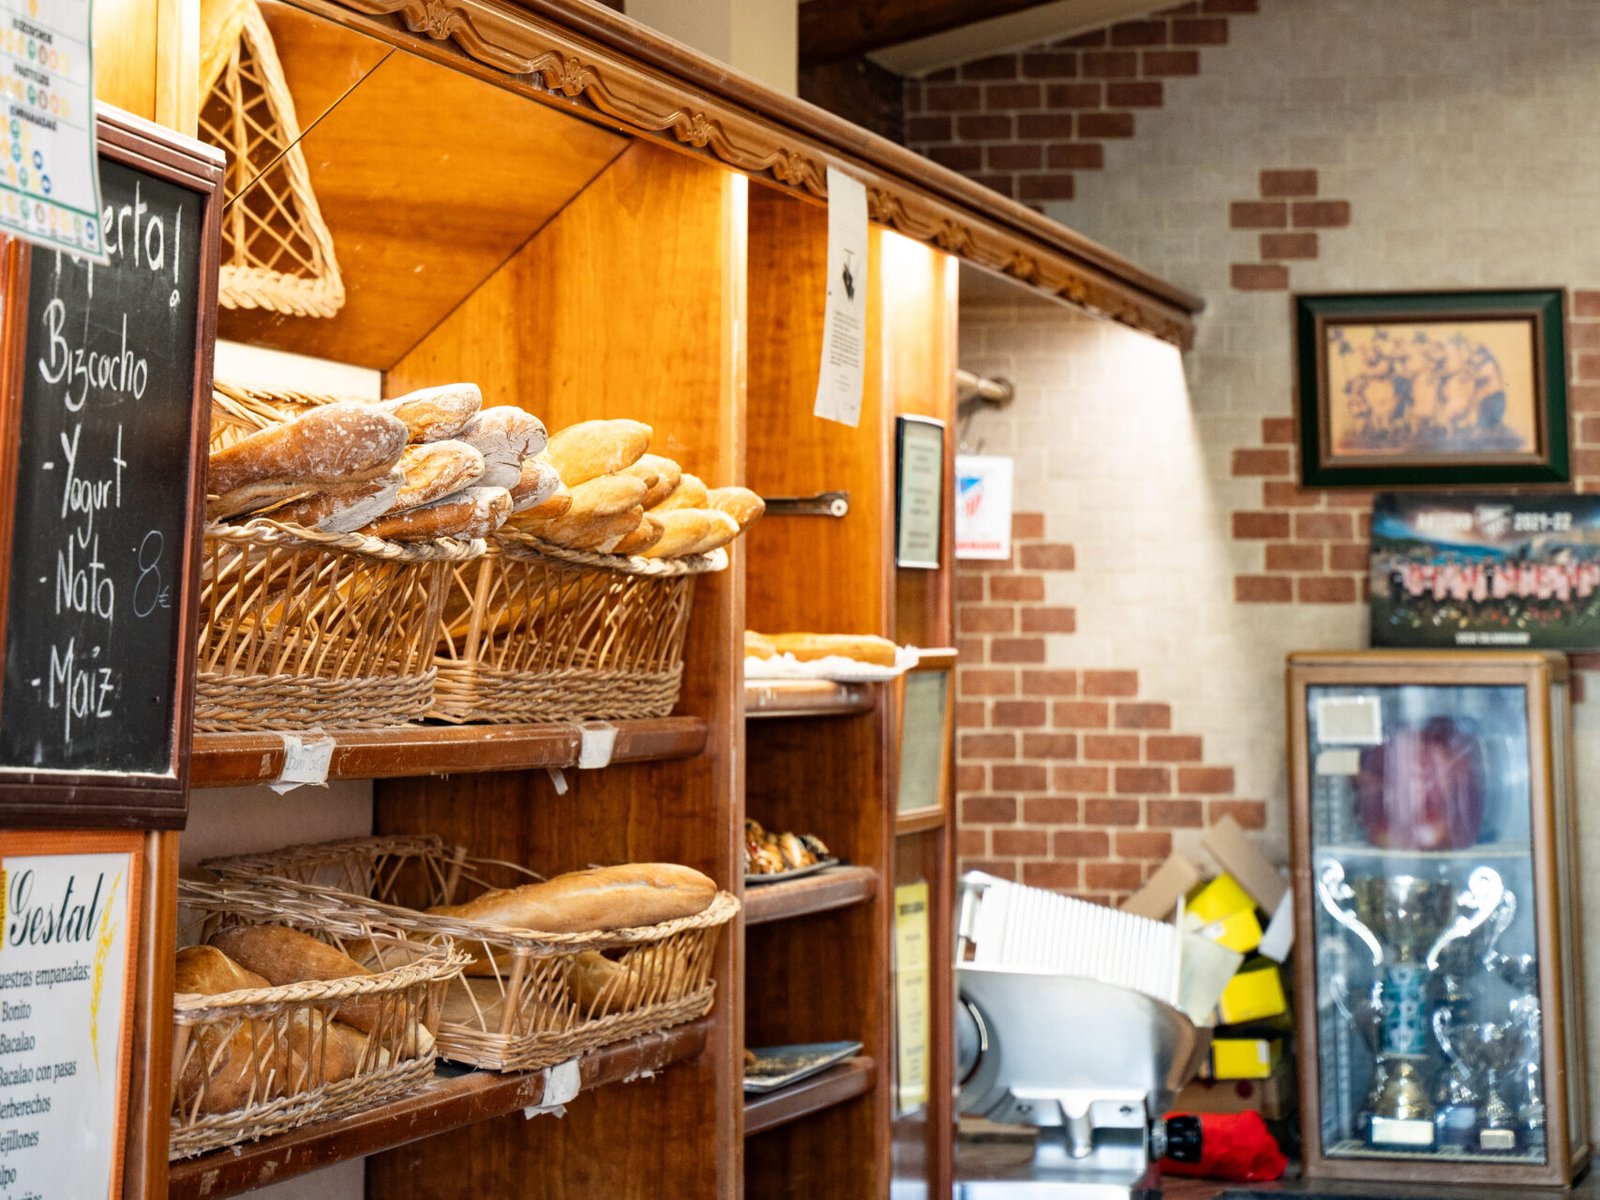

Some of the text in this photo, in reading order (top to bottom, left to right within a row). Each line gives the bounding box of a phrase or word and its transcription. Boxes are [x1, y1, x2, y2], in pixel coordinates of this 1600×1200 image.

[38, 297, 148, 412] Bizcocho
[9, 868, 105, 948] Gestal
[2, 1000, 32, 1022] Bonito
[0, 1030, 36, 1055] Bacalao
[35, 1065, 52, 1082] con
[53, 1060, 77, 1084] pasas
[0, 1093, 51, 1120] erberechos
[0, 1129, 39, 1157] ejillones
